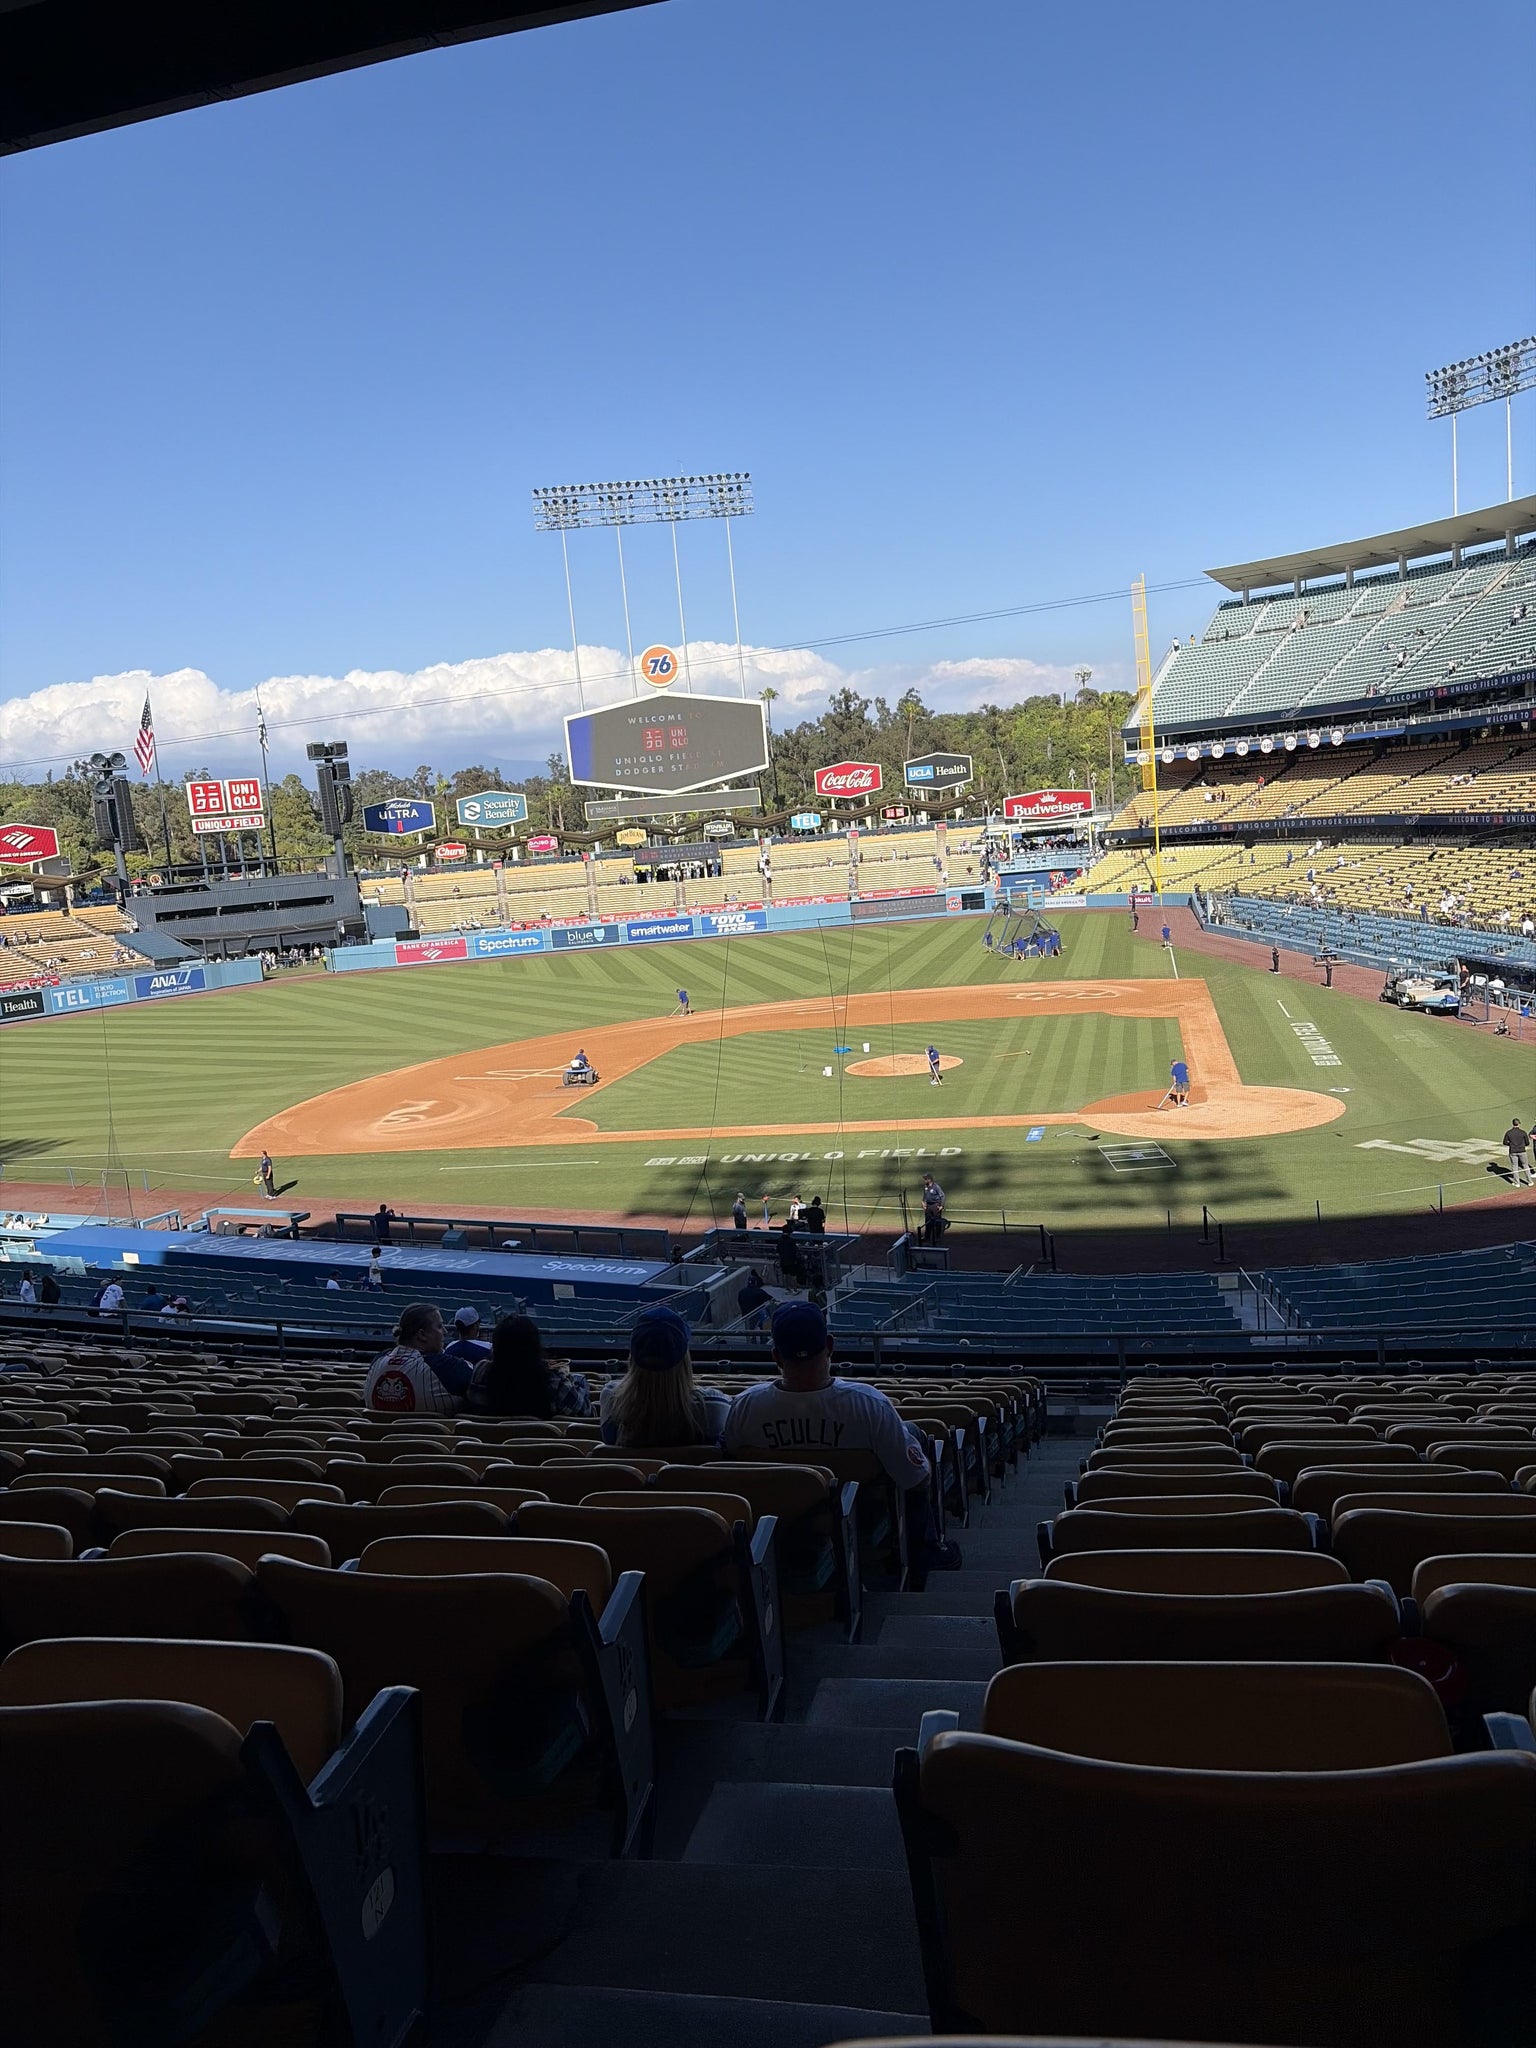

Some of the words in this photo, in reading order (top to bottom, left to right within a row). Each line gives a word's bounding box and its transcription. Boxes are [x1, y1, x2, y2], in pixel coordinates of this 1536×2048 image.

[649, 654, 672, 675] 76
[1385, 693, 1421, 703] WELCOME
[1451, 683, 1477, 693] UNIQLO
[1480, 679, 1499, 688] FIELD
[1502, 676, 1509, 684] AT
[1512, 672, 1536, 683] DODGE
[628, 714, 682, 724] WELCOME
[1486, 714, 1518, 723] WELCOME
[1521, 711, 1530, 719] TO
[615, 754, 663, 765] UNIQLO
[615, 765, 664, 776] DODGER
[909, 769, 932, 778] UCLA
[935, 764, 967, 776] Health
[821, 768, 873, 791] Coca-Cola
[232, 784, 254, 794] UNI
[233, 795, 258, 808] QLO
[484, 799, 520, 810] Security
[379, 809, 419, 820] ULTRA
[485, 809, 517, 819] Benefit
[1013, 801, 1084, 817] Budweiser
[198, 820, 231, 830] UNIQLO
[234, 817, 260, 828] FIELD
[794, 815, 818, 827] TEL
[1161, 826, 1203, 834] WELCOME
[1238, 822, 1270, 830] UNIQLO
[1274, 820, 1296, 828] FIELD
[1311, 818, 1342, 826] DODGER
[1345, 816, 1376, 824] STADIUM
[436, 846, 466, 857] Churu
[1053, 873, 1063, 883] 76
[710, 914, 746, 925] TOYO
[630, 923, 690, 937] smartwater
[717, 921, 755, 933] TIRES
[567, 931, 593, 941] blue
[431, 940, 459, 948] AMERICA
[479, 937, 537, 952] Spectrum
[94, 984, 113, 992] TOKYO
[150, 975, 177, 989] ANA
[53, 989, 89, 1007] TEL
[95, 989, 126, 998] ELECTRON
[4, 999, 38, 1013] Health
[720, 1151, 844, 1164] UNIQLO
[857, 1147, 963, 1160] FIELD
[542, 1261, 643, 1275] Spectrum
[762, 1418, 844, 1448] SCULLY
